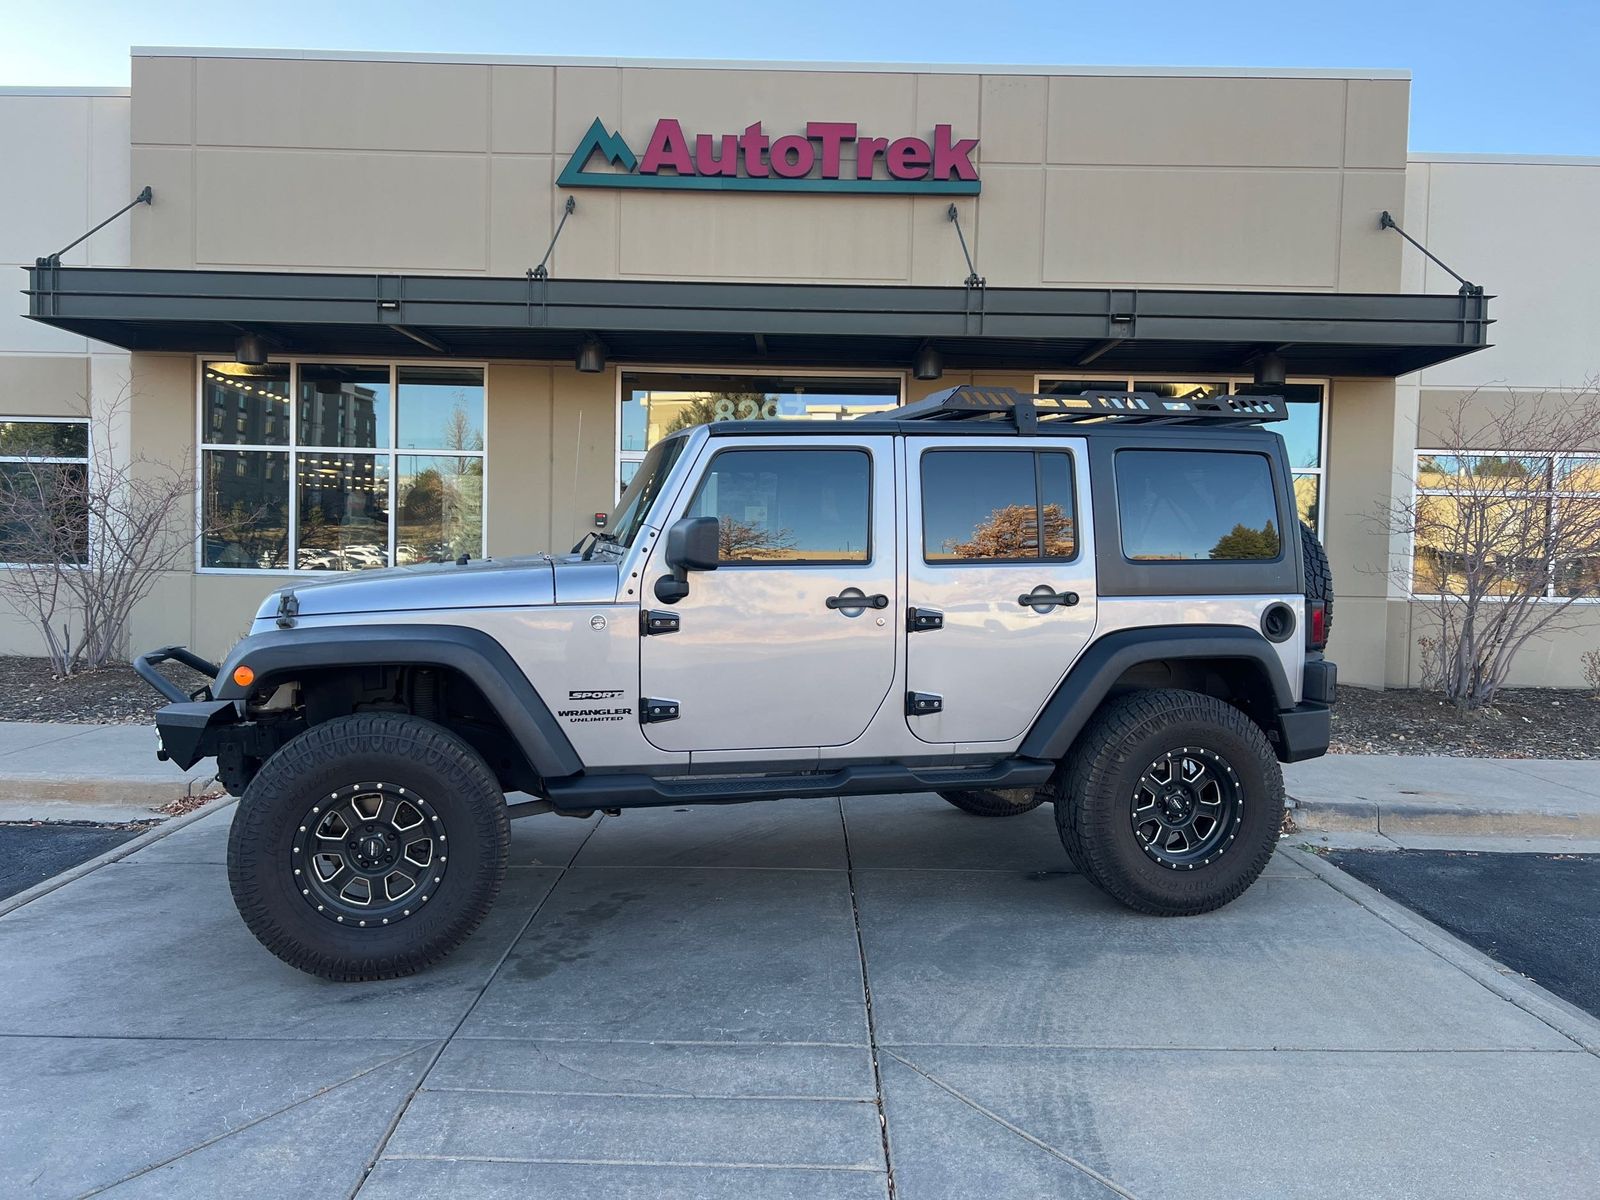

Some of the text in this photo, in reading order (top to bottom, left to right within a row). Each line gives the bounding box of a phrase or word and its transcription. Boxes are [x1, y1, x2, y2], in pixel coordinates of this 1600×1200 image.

[639, 118, 979, 180] AutoTrek
[570, 690, 624, 700] SPORT
[558, 708, 632, 717] WRANGLER
